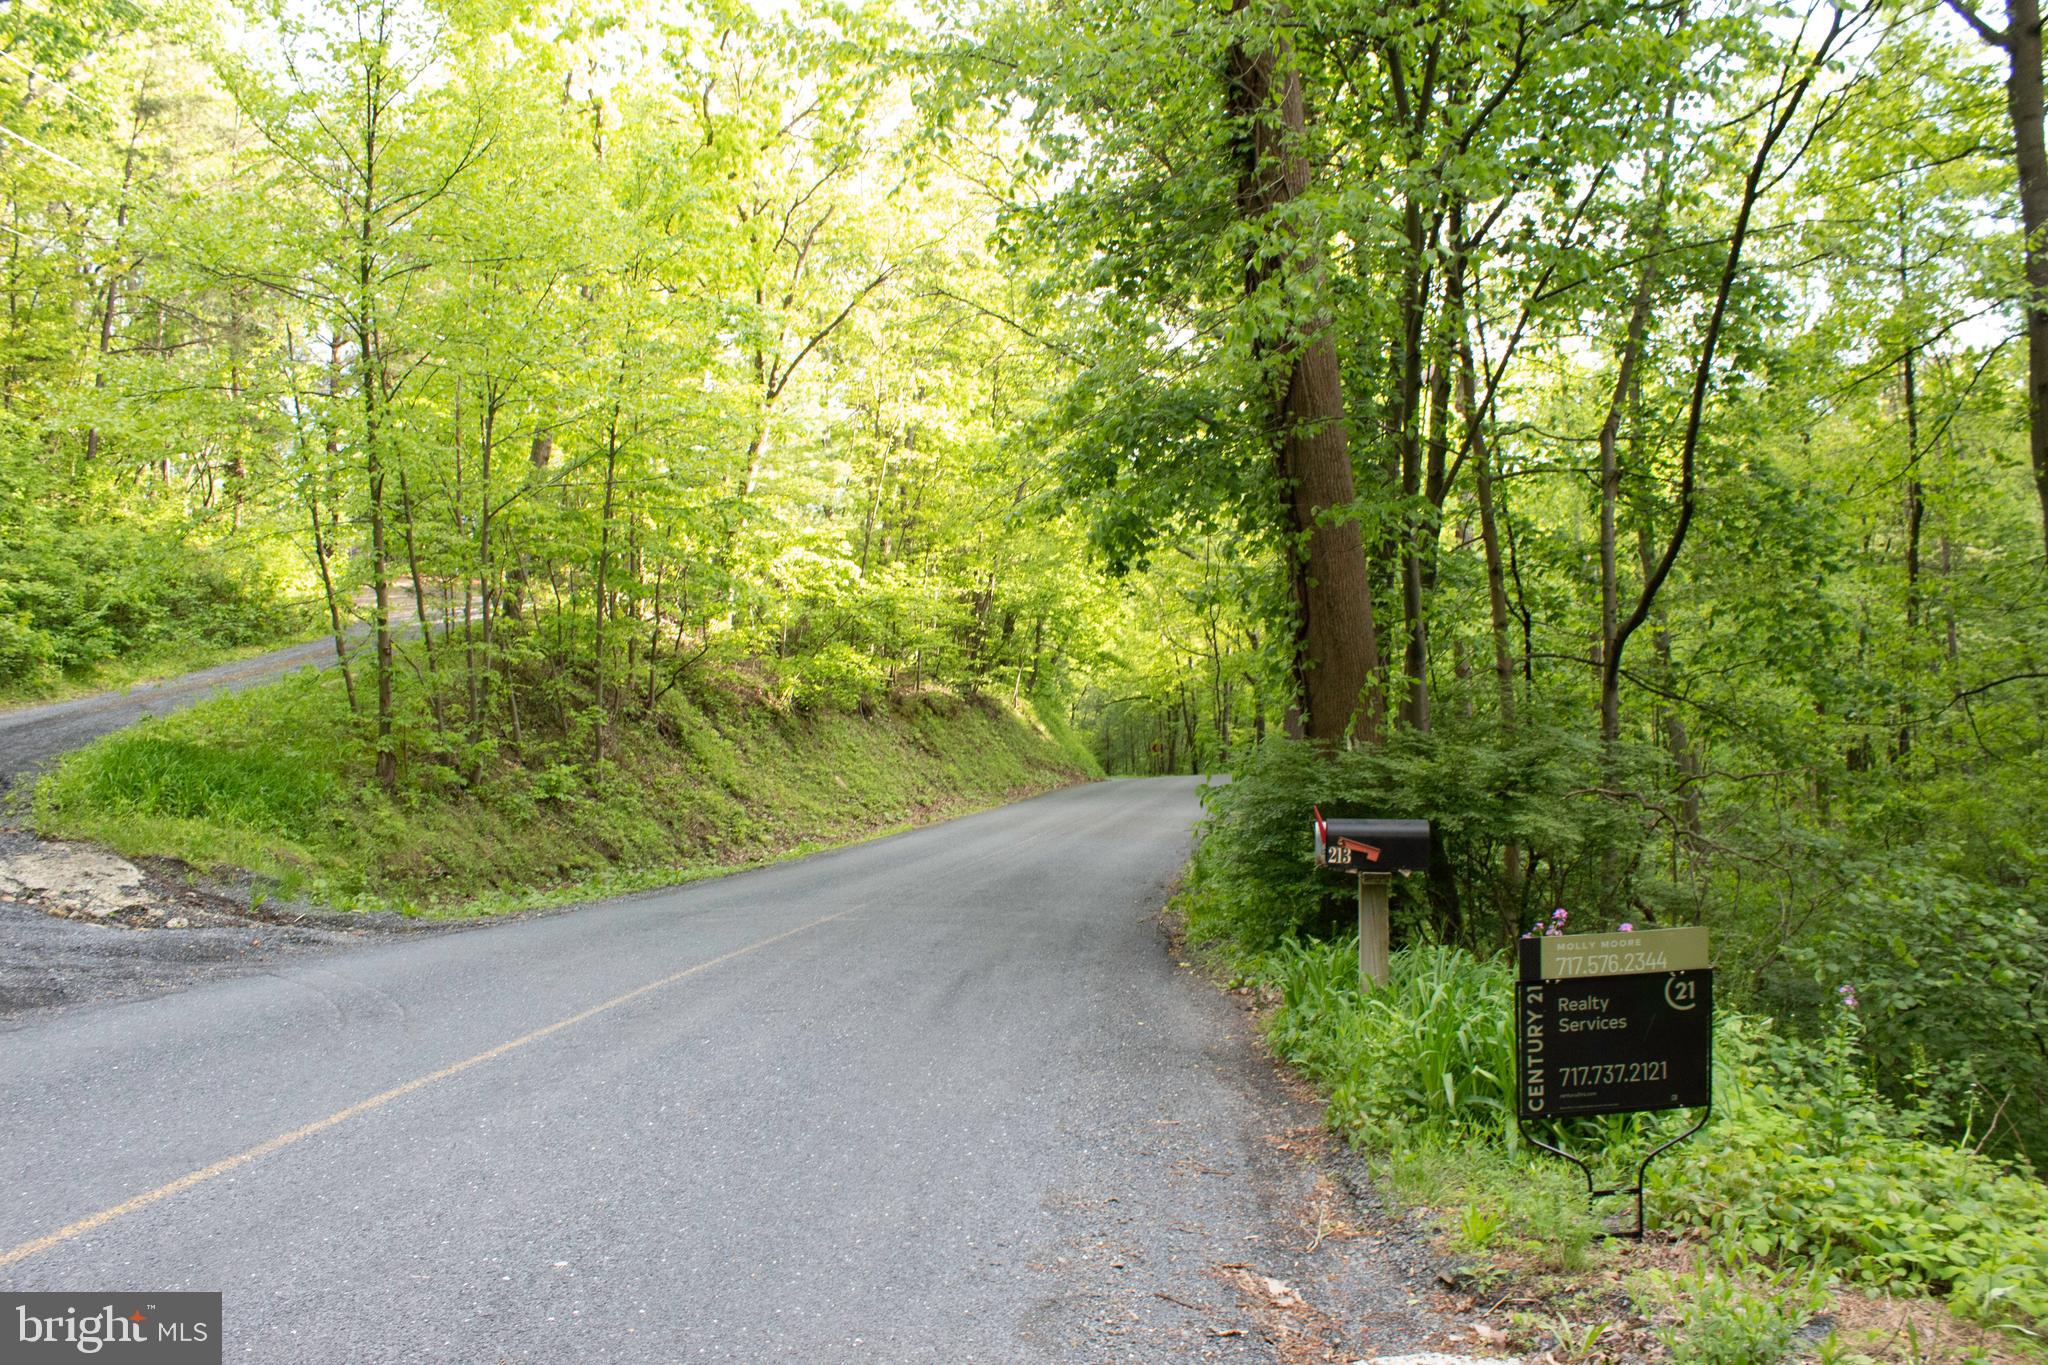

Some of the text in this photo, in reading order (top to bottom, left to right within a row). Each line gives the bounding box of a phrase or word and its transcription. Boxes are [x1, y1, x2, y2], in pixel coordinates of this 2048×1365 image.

[1327, 846, 1352, 864] 213
[1556, 938, 1642, 951] MOLLY MOORE
[1556, 951, 1667, 976] 717.576.2344
[1558, 995, 1610, 1012] Realty
[1559, 1016, 1628, 1033] Services
[1527, 985, 1544, 1112] CENTURY 21
[1559, 1061, 1668, 1087] 717.737.2121
